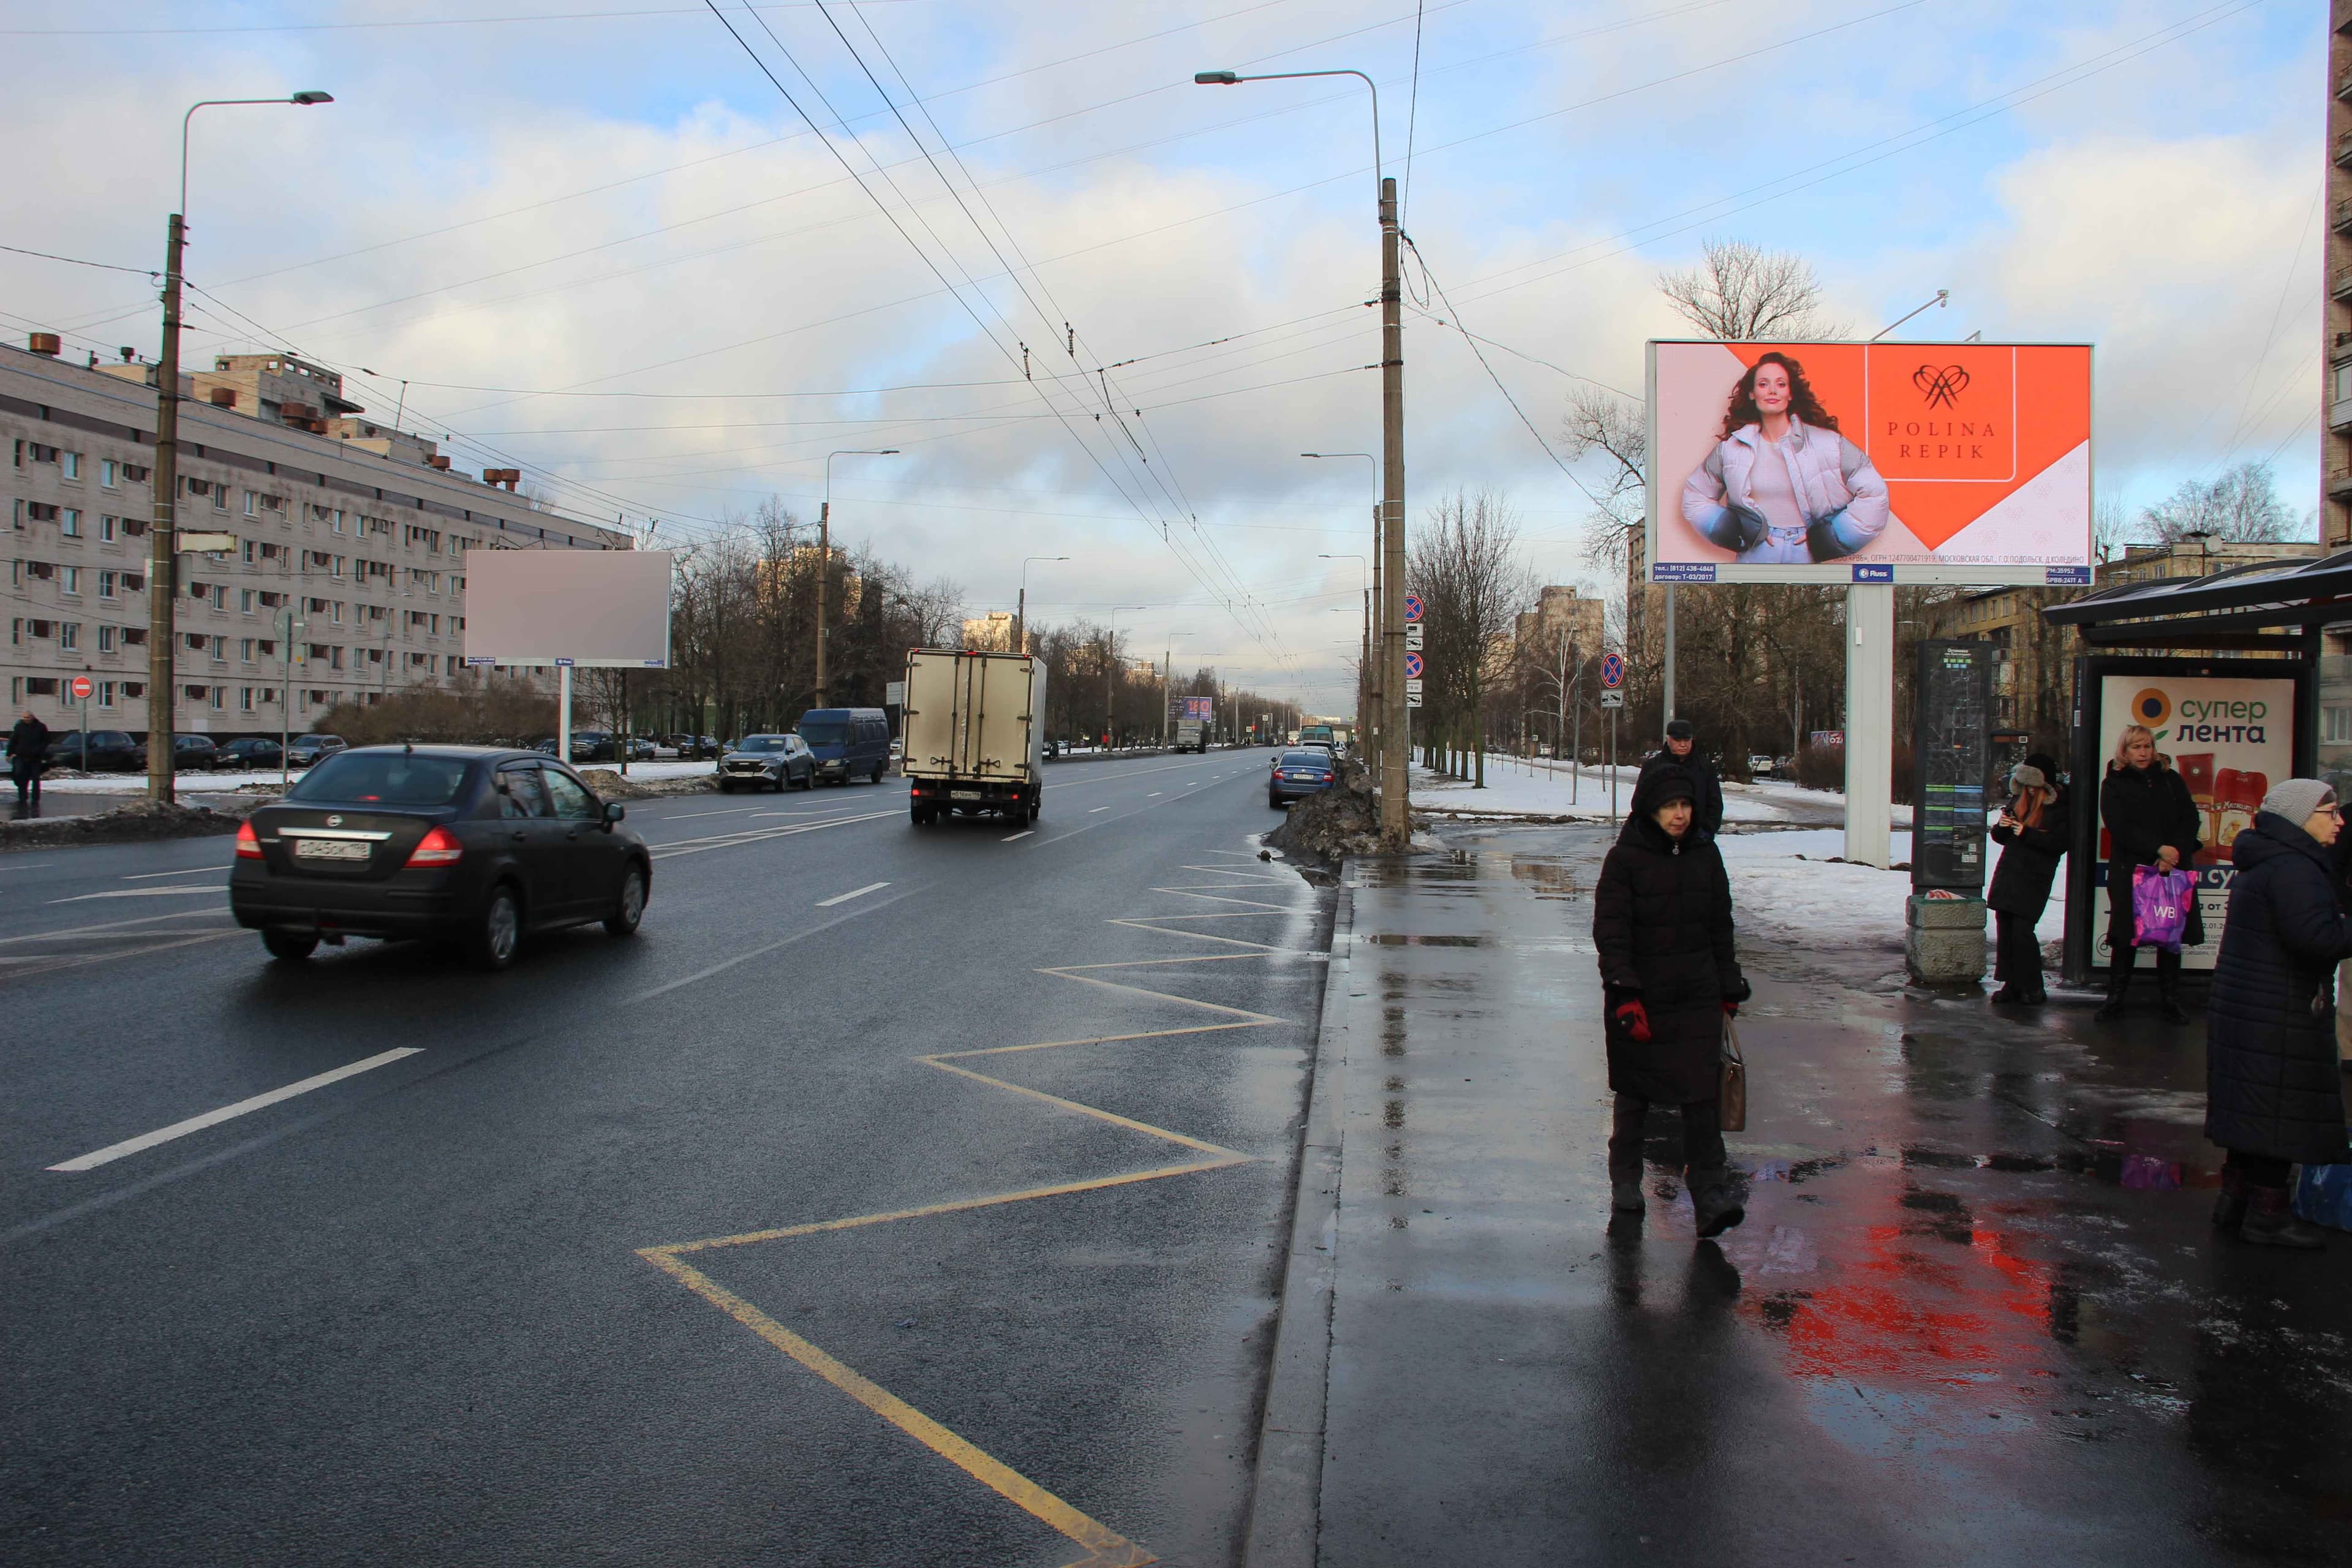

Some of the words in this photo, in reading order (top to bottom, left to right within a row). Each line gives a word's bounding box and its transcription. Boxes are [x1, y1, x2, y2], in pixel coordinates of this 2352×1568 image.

[1888, 422, 1994, 437] POLINA
[1899, 444, 1983, 459] REPIK
[2180, 700, 2267, 723] супер
[2176, 725, 2266, 743] лента
[2207, 870, 2239, 889] су
[2154, 905, 2176, 918] WB
